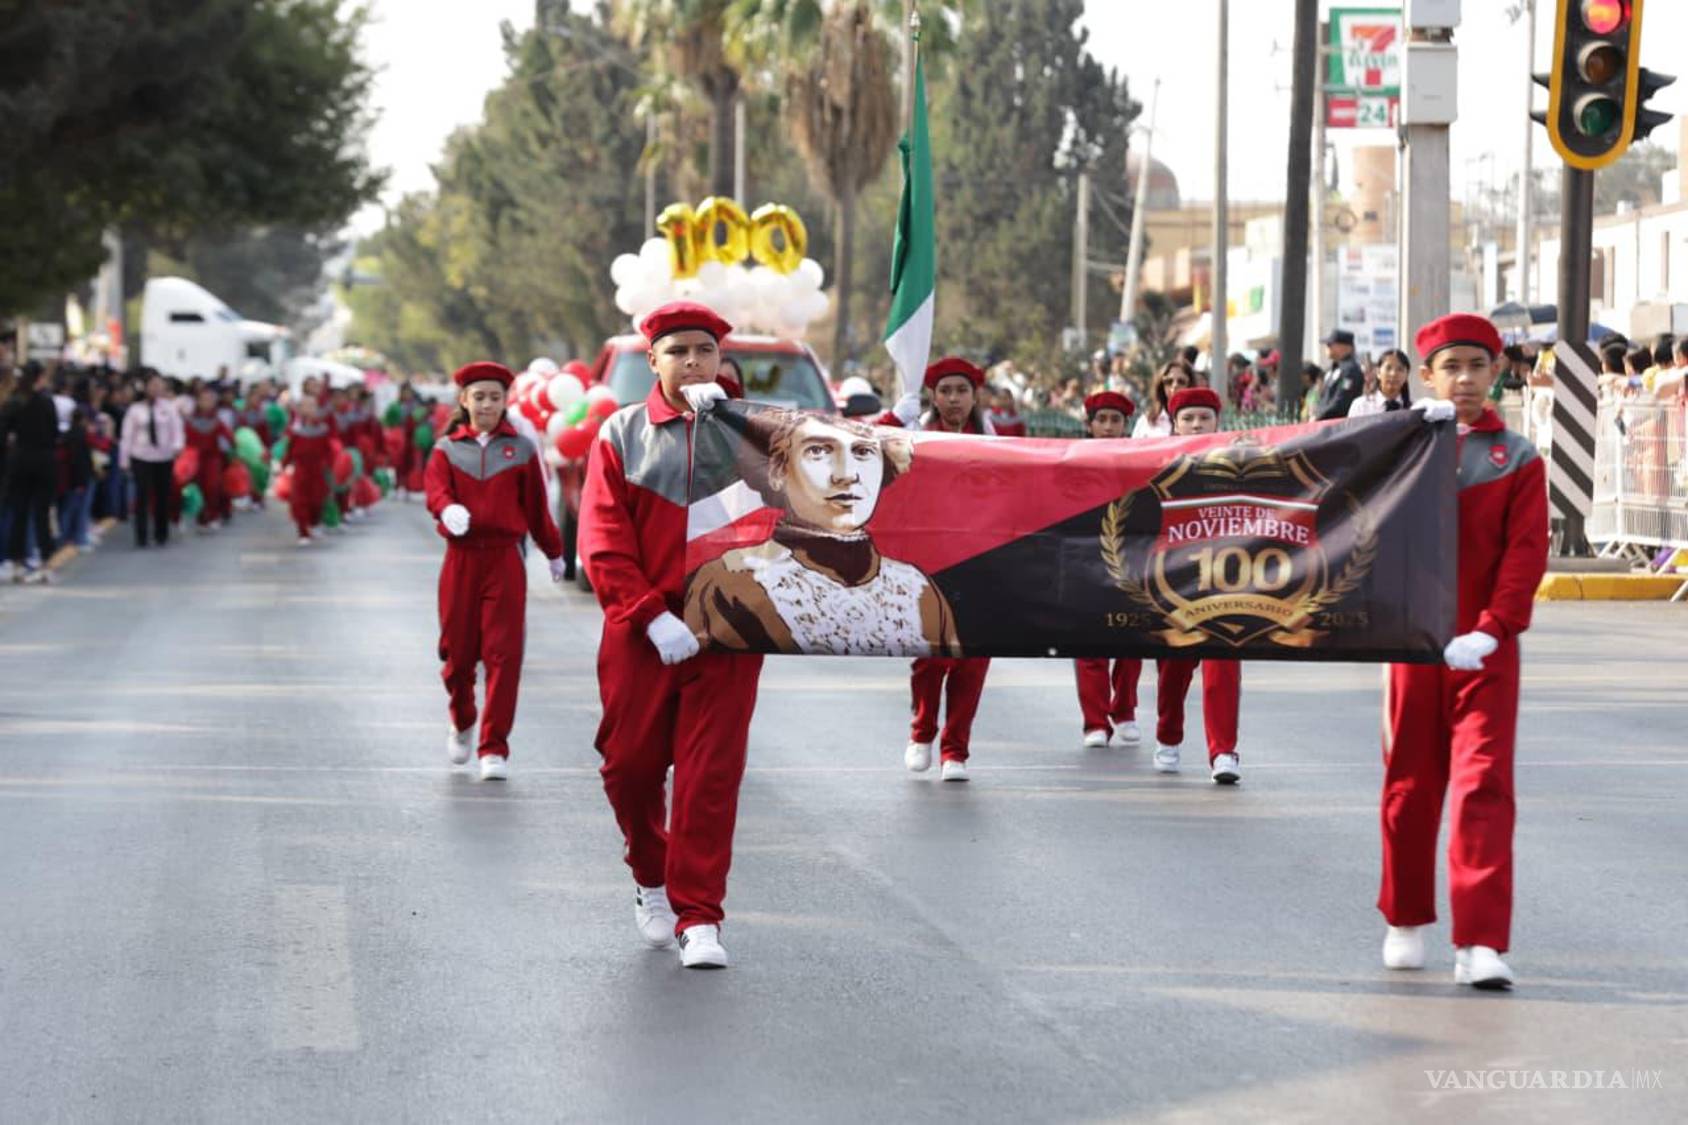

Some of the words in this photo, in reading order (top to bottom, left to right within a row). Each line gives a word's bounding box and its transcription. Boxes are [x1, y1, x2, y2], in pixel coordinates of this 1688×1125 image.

[1359, 103, 1386, 122] 24
[656, 196, 808, 279] 100
[1198, 505, 1253, 519] VEINTE
[1256, 508, 1275, 521] DE
[1167, 517, 1310, 545] NOVIEMBRE
[1189, 546, 1293, 592] 100
[1183, 600, 1294, 619] ANIVERSARIO
